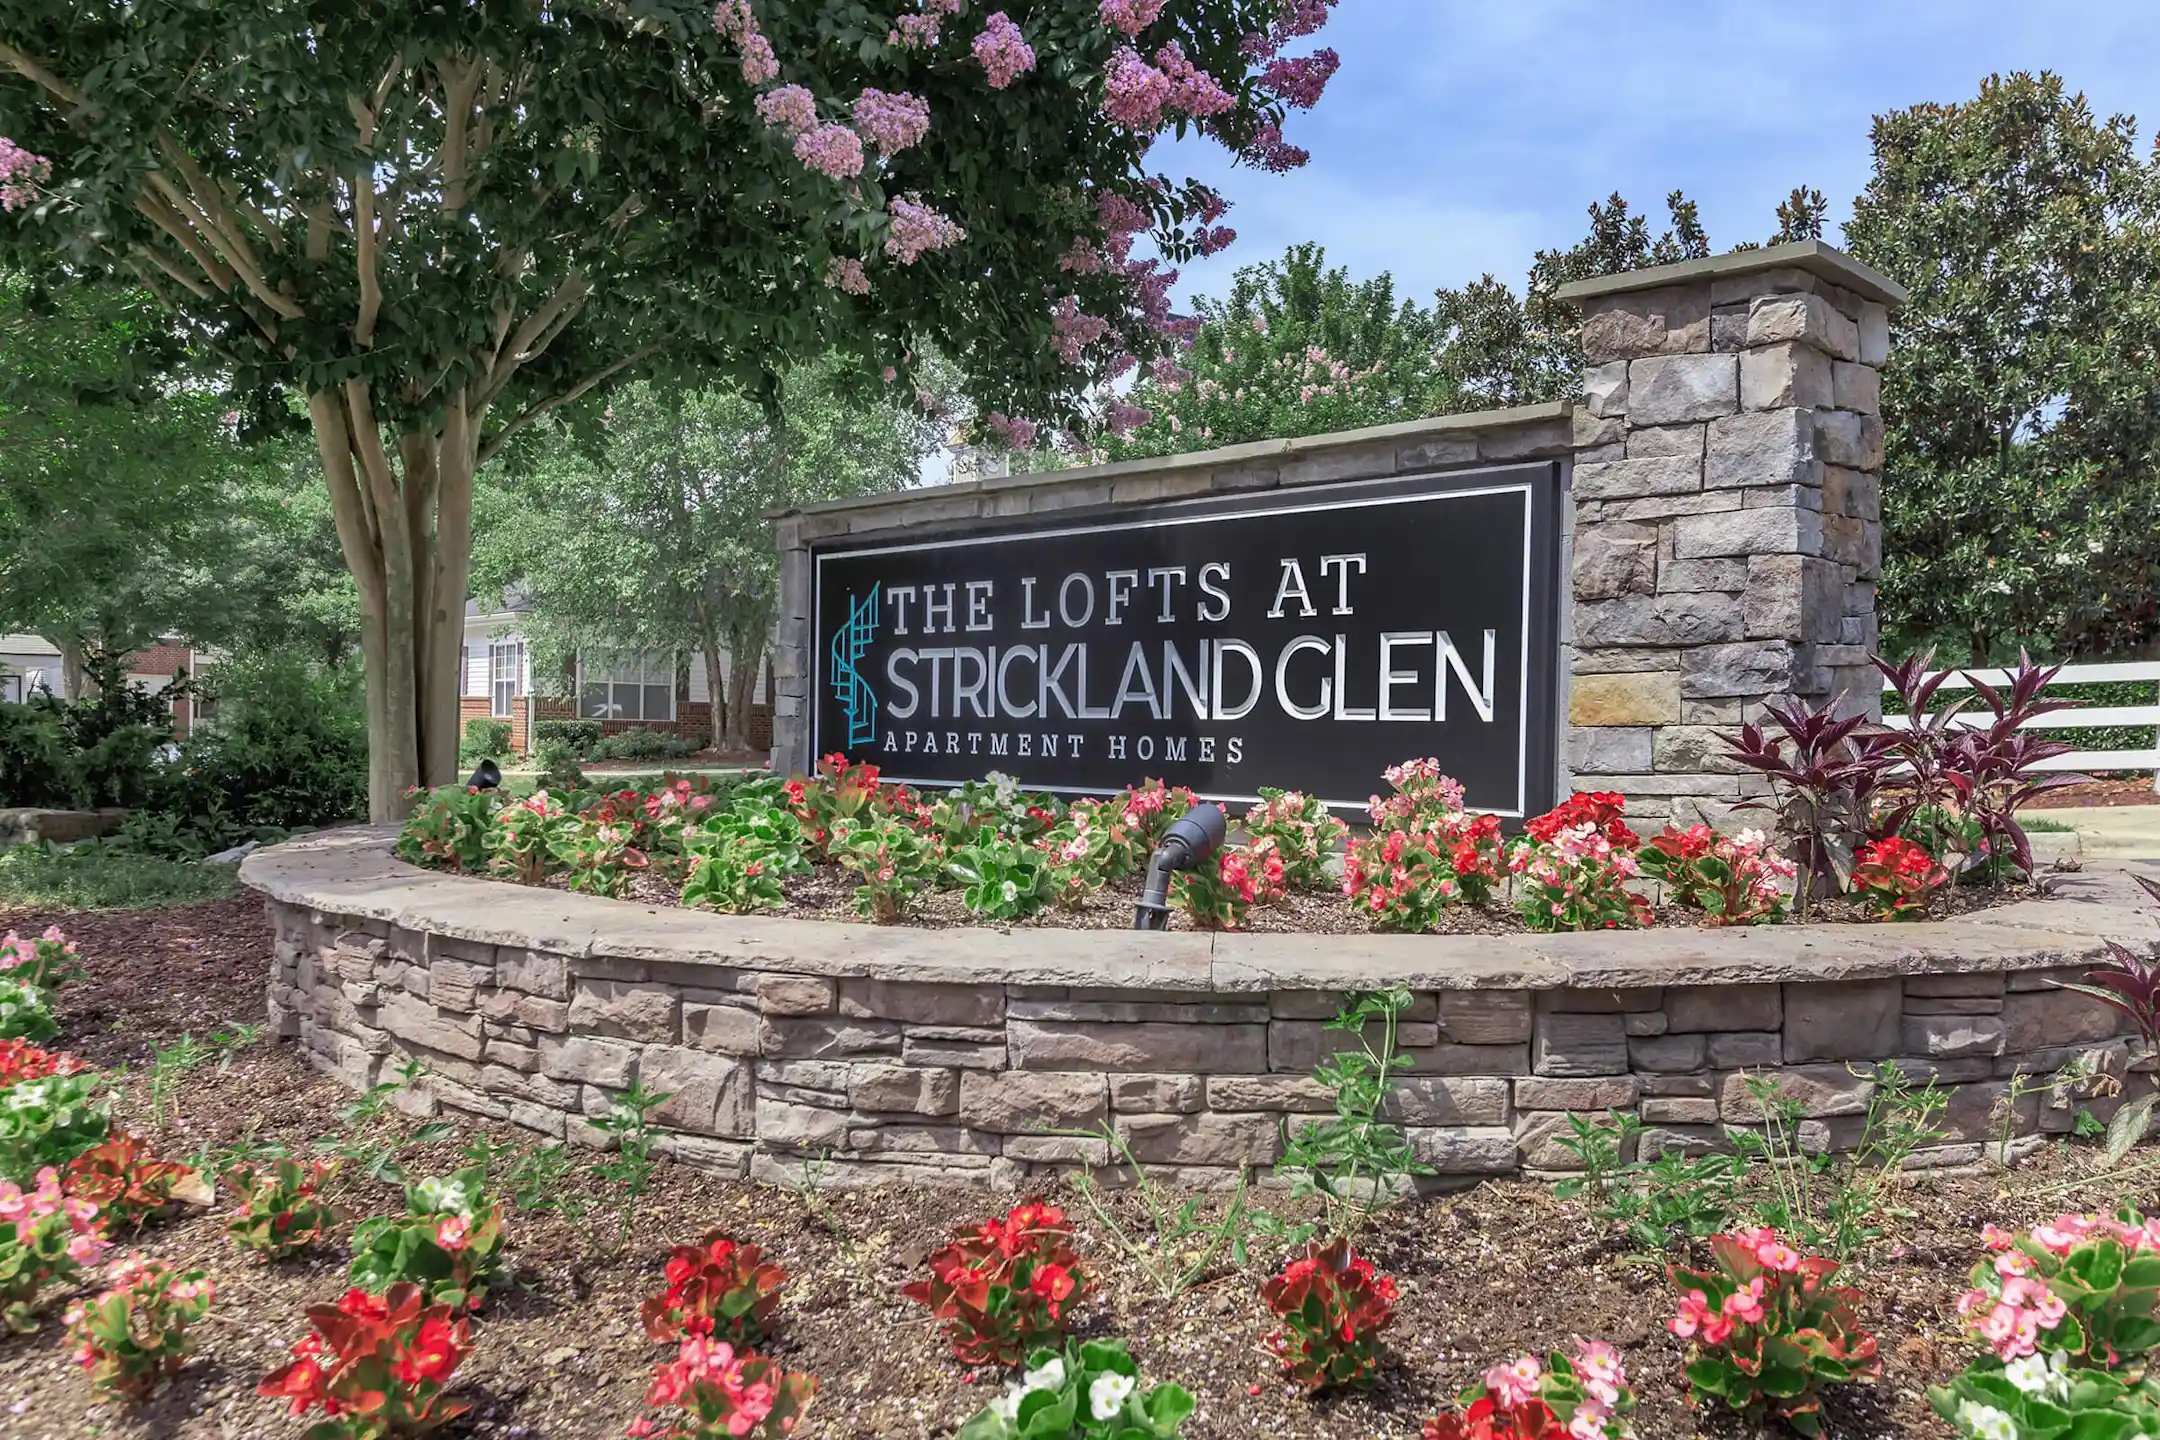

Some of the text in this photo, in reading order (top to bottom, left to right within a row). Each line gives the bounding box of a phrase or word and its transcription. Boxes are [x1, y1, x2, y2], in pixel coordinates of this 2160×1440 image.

[886, 552, 1367, 635] THE LOFTS AT
[883, 731, 1244, 764] APARTMENT HOMES
